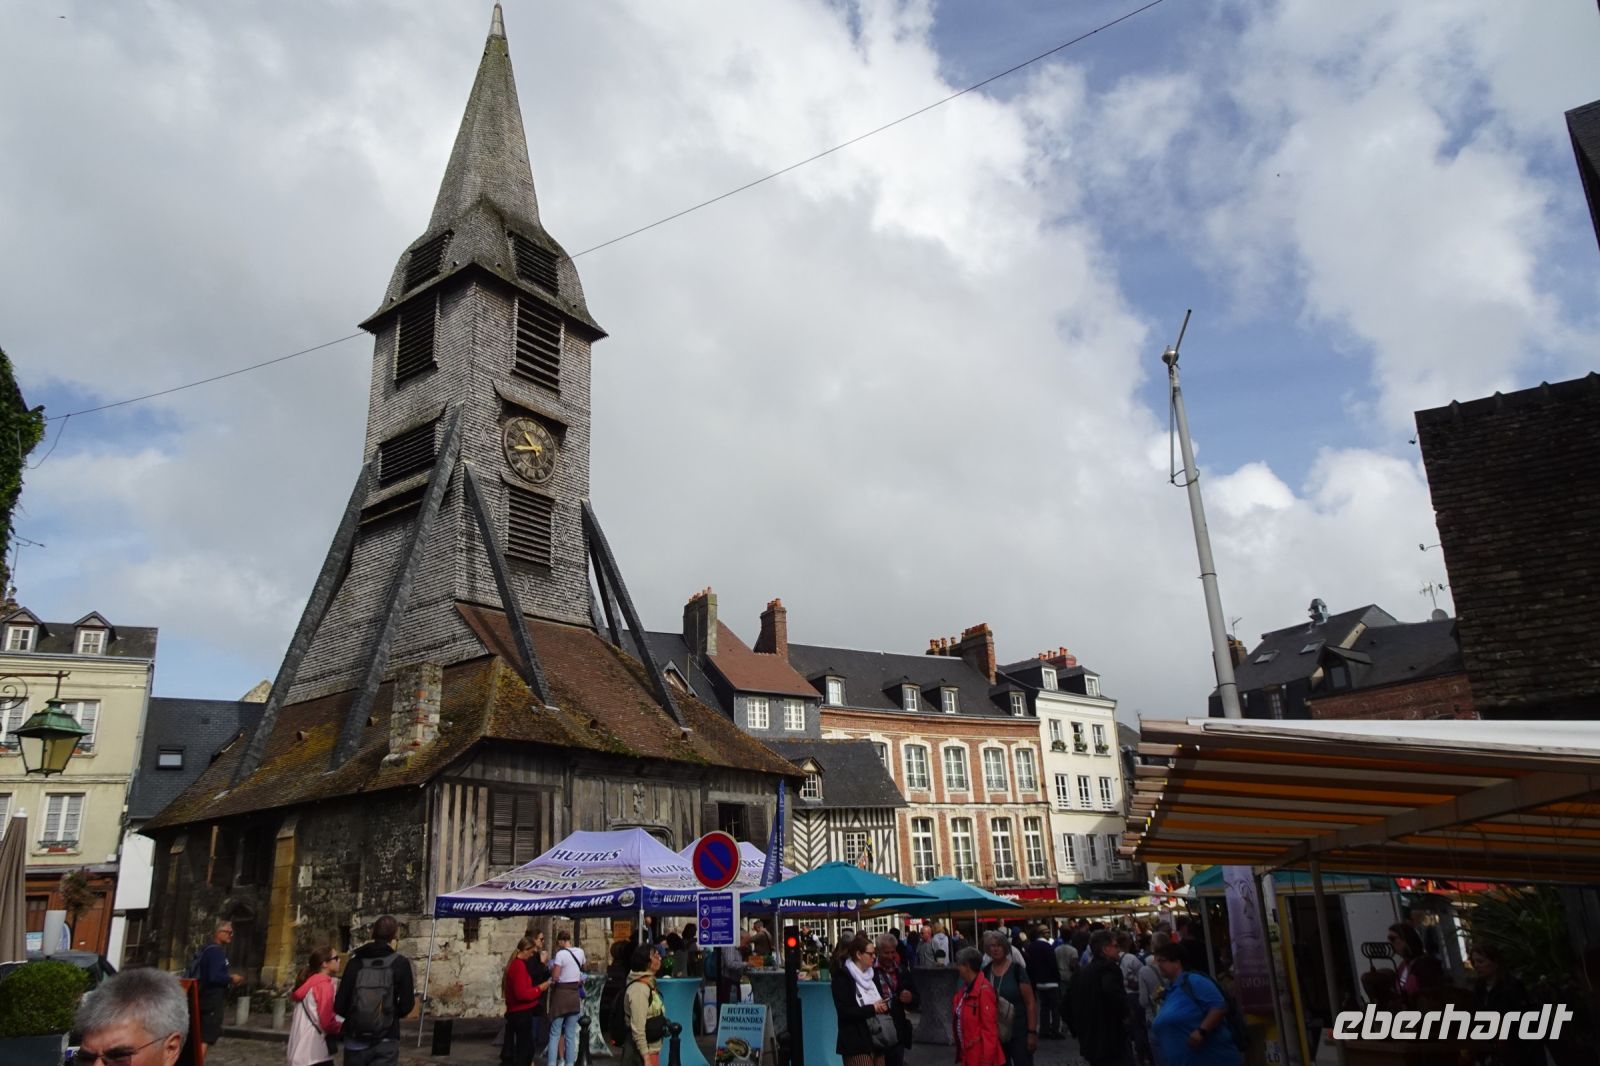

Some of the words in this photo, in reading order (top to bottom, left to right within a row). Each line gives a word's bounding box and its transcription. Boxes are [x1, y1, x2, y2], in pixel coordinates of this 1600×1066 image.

[551, 849, 623, 862] HUITRES
[560, 867, 582, 878] de
[506, 879, 607, 890] NORMANDIE
[453, 902, 494, 912] HUITRES
[494, 902, 509, 912] DE
[509, 899, 569, 912] BLAINVILLE
[569, 900, 588, 908] sur
[588, 895, 614, 907] MER
[663, 894, 692, 903] HUITRES
[727, 1007, 760, 1015] HUITRES
[721, 1015, 764, 1024] NORMANDES
